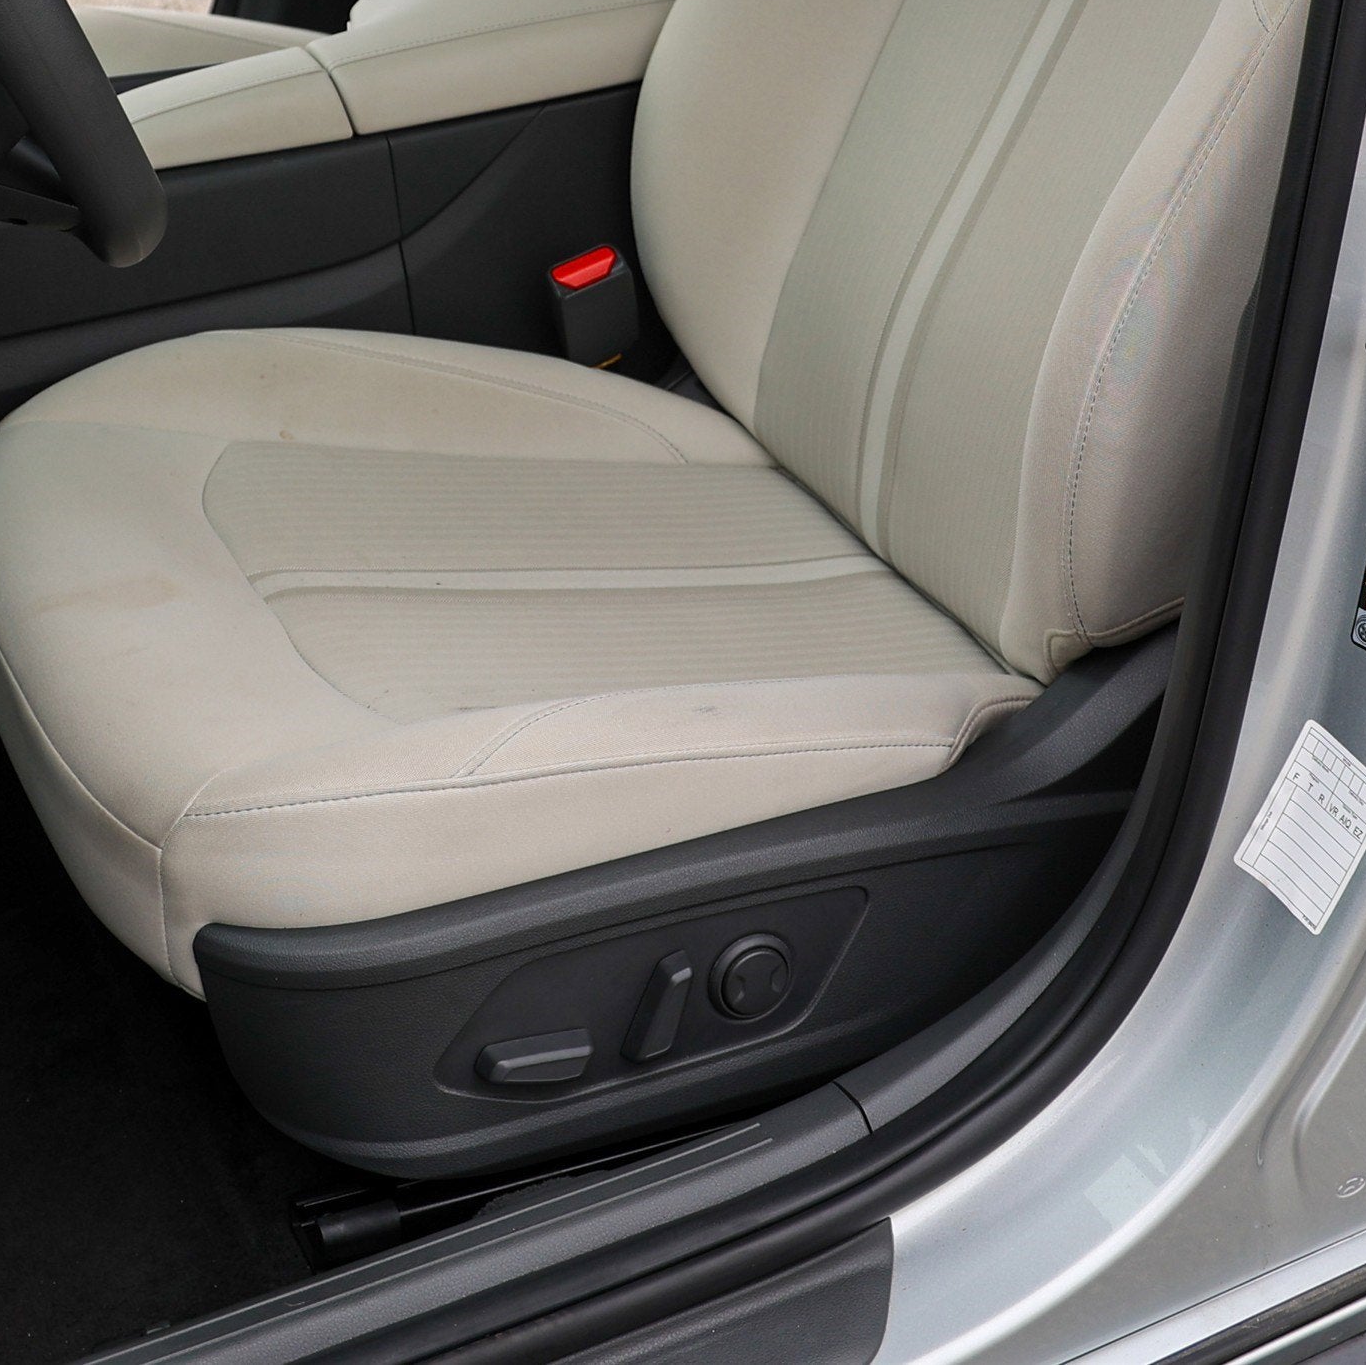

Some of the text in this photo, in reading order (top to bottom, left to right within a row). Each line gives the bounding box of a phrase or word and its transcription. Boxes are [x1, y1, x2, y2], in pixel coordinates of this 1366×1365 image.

[1292, 772, 1299, 781] F
[1307, 783, 1314, 792] T
[1318, 794, 1324, 805] R
[1329, 803, 1338, 818] VR
[1352, 827, 1364, 839] EZ
